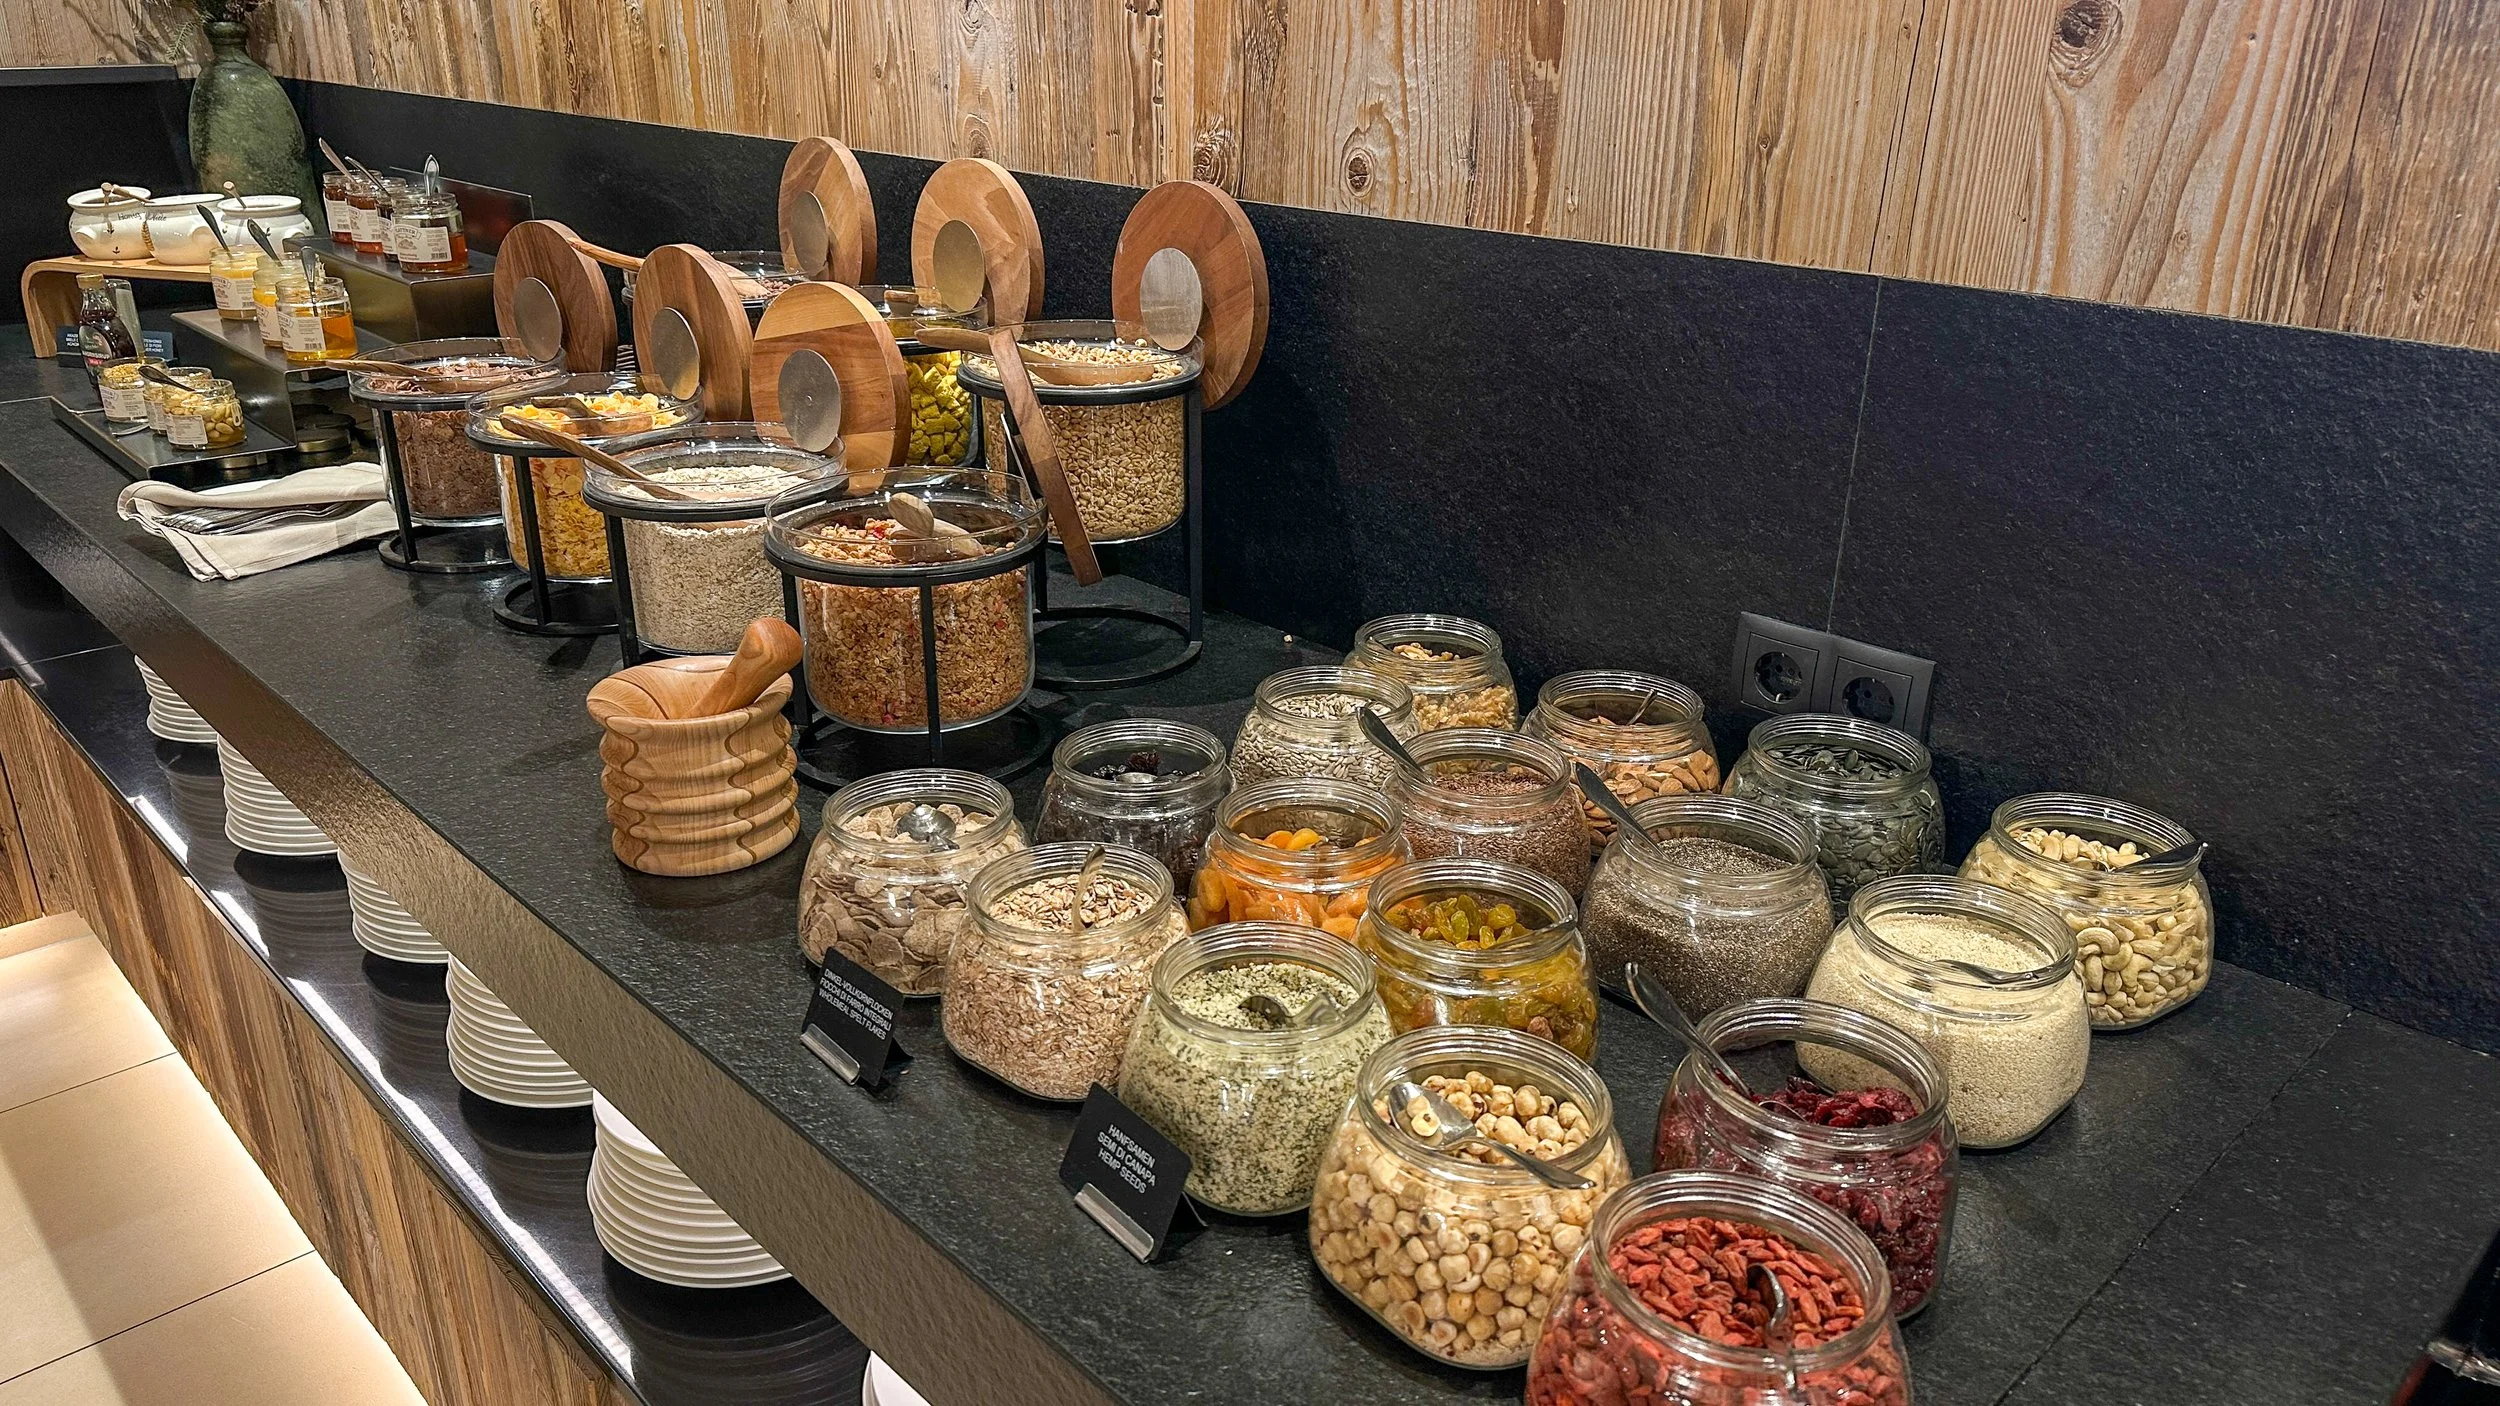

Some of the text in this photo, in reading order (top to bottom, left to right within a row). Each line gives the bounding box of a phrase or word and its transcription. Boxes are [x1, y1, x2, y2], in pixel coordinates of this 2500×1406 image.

[819, 989, 887, 1040] WHOLEMEAL SPELT FLAKES
[820, 977, 891, 1031] FIOCCHI DI FARRO INTEGRALI
[824, 968, 893, 1020] DINKEL-VOLLKORNFLOCKEN
[1097, 1132, 1156, 1186] SEMI DI CANAPA
[1098, 1148, 1147, 1193] HEMP SEEDS
[1108, 1124, 1155, 1168] HANFSAMEN
